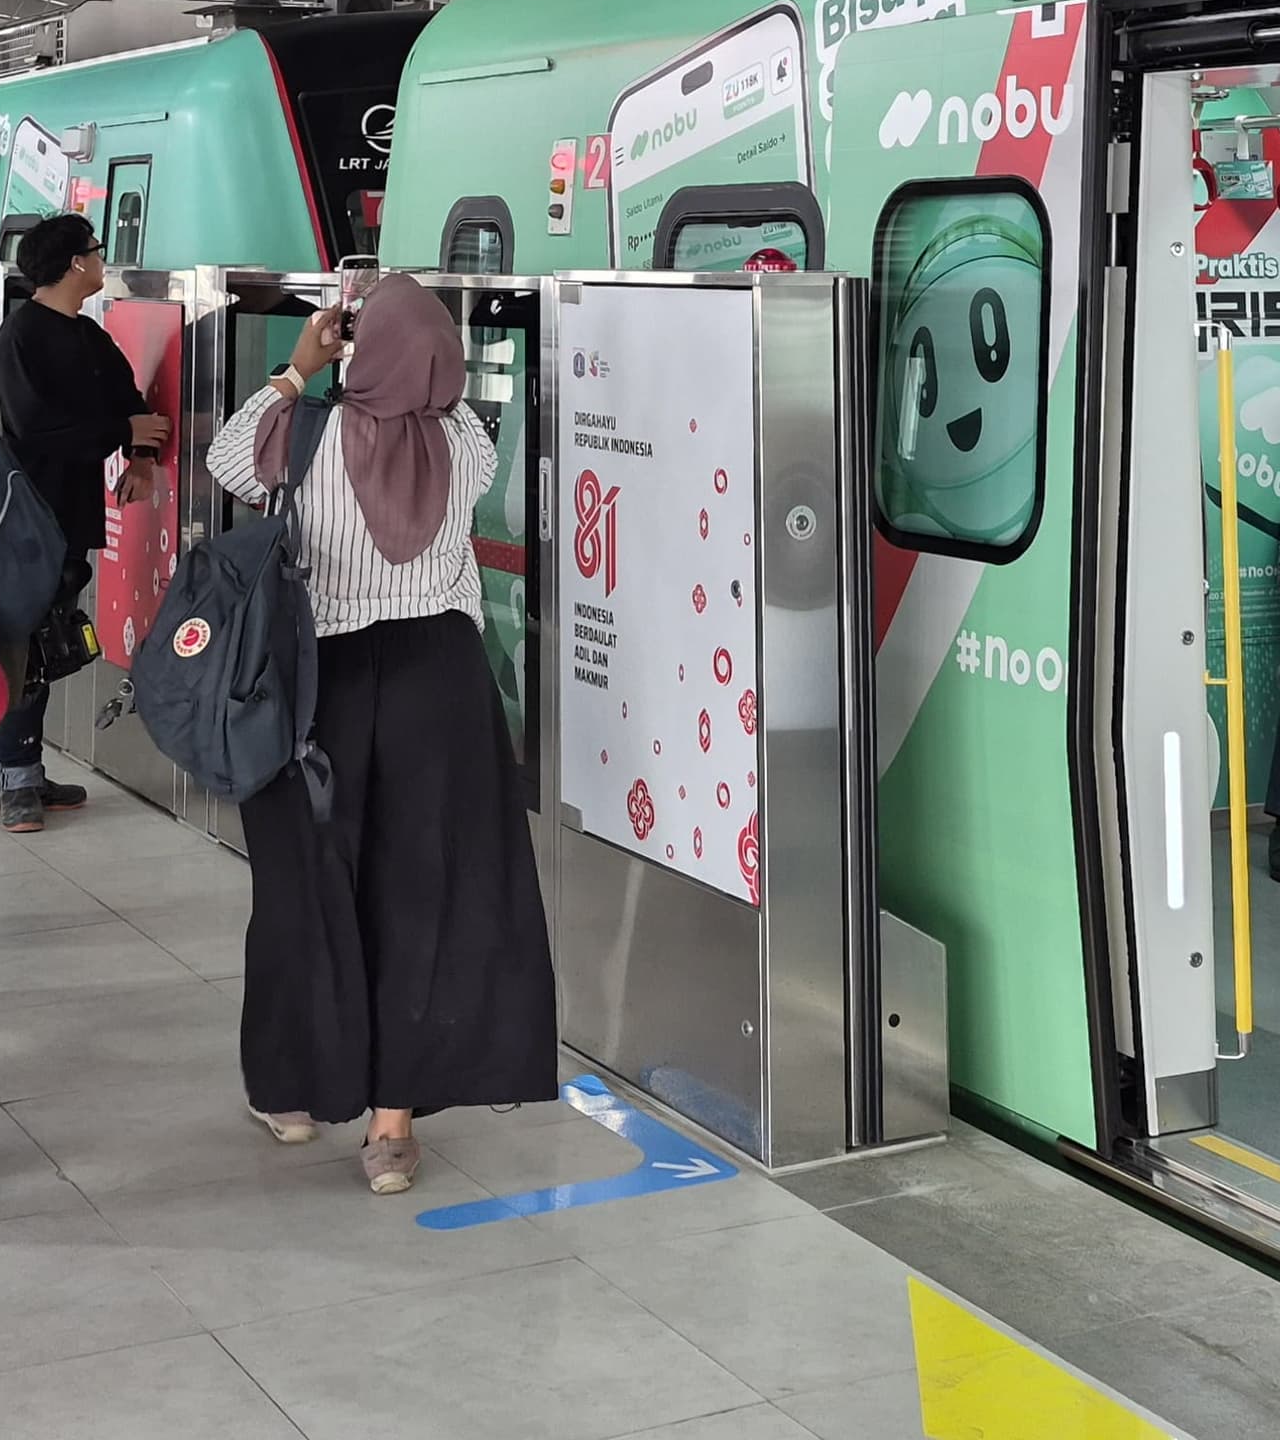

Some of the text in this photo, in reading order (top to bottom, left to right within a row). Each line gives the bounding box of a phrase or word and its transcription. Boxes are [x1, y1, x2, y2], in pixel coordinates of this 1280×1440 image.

[938, 74, 1075, 145] nobu
[651, 108, 698, 151] nobu
[339, 158, 371, 170] LRT
[586, 136, 607, 188] 2
[1195, 252, 1279, 278] Praktis
[574, 411, 617, 431] DIRGAHAYU
[574, 432, 654, 458] REPUBLIK INDONESIA
[574, 468, 622, 600] 81
[574, 601, 614, 627] INDONESIA
[574, 623, 617, 649] BERDAULAT
[574, 644, 609, 668] ADIL DAN
[574, 666, 609, 690] MAKMUR
